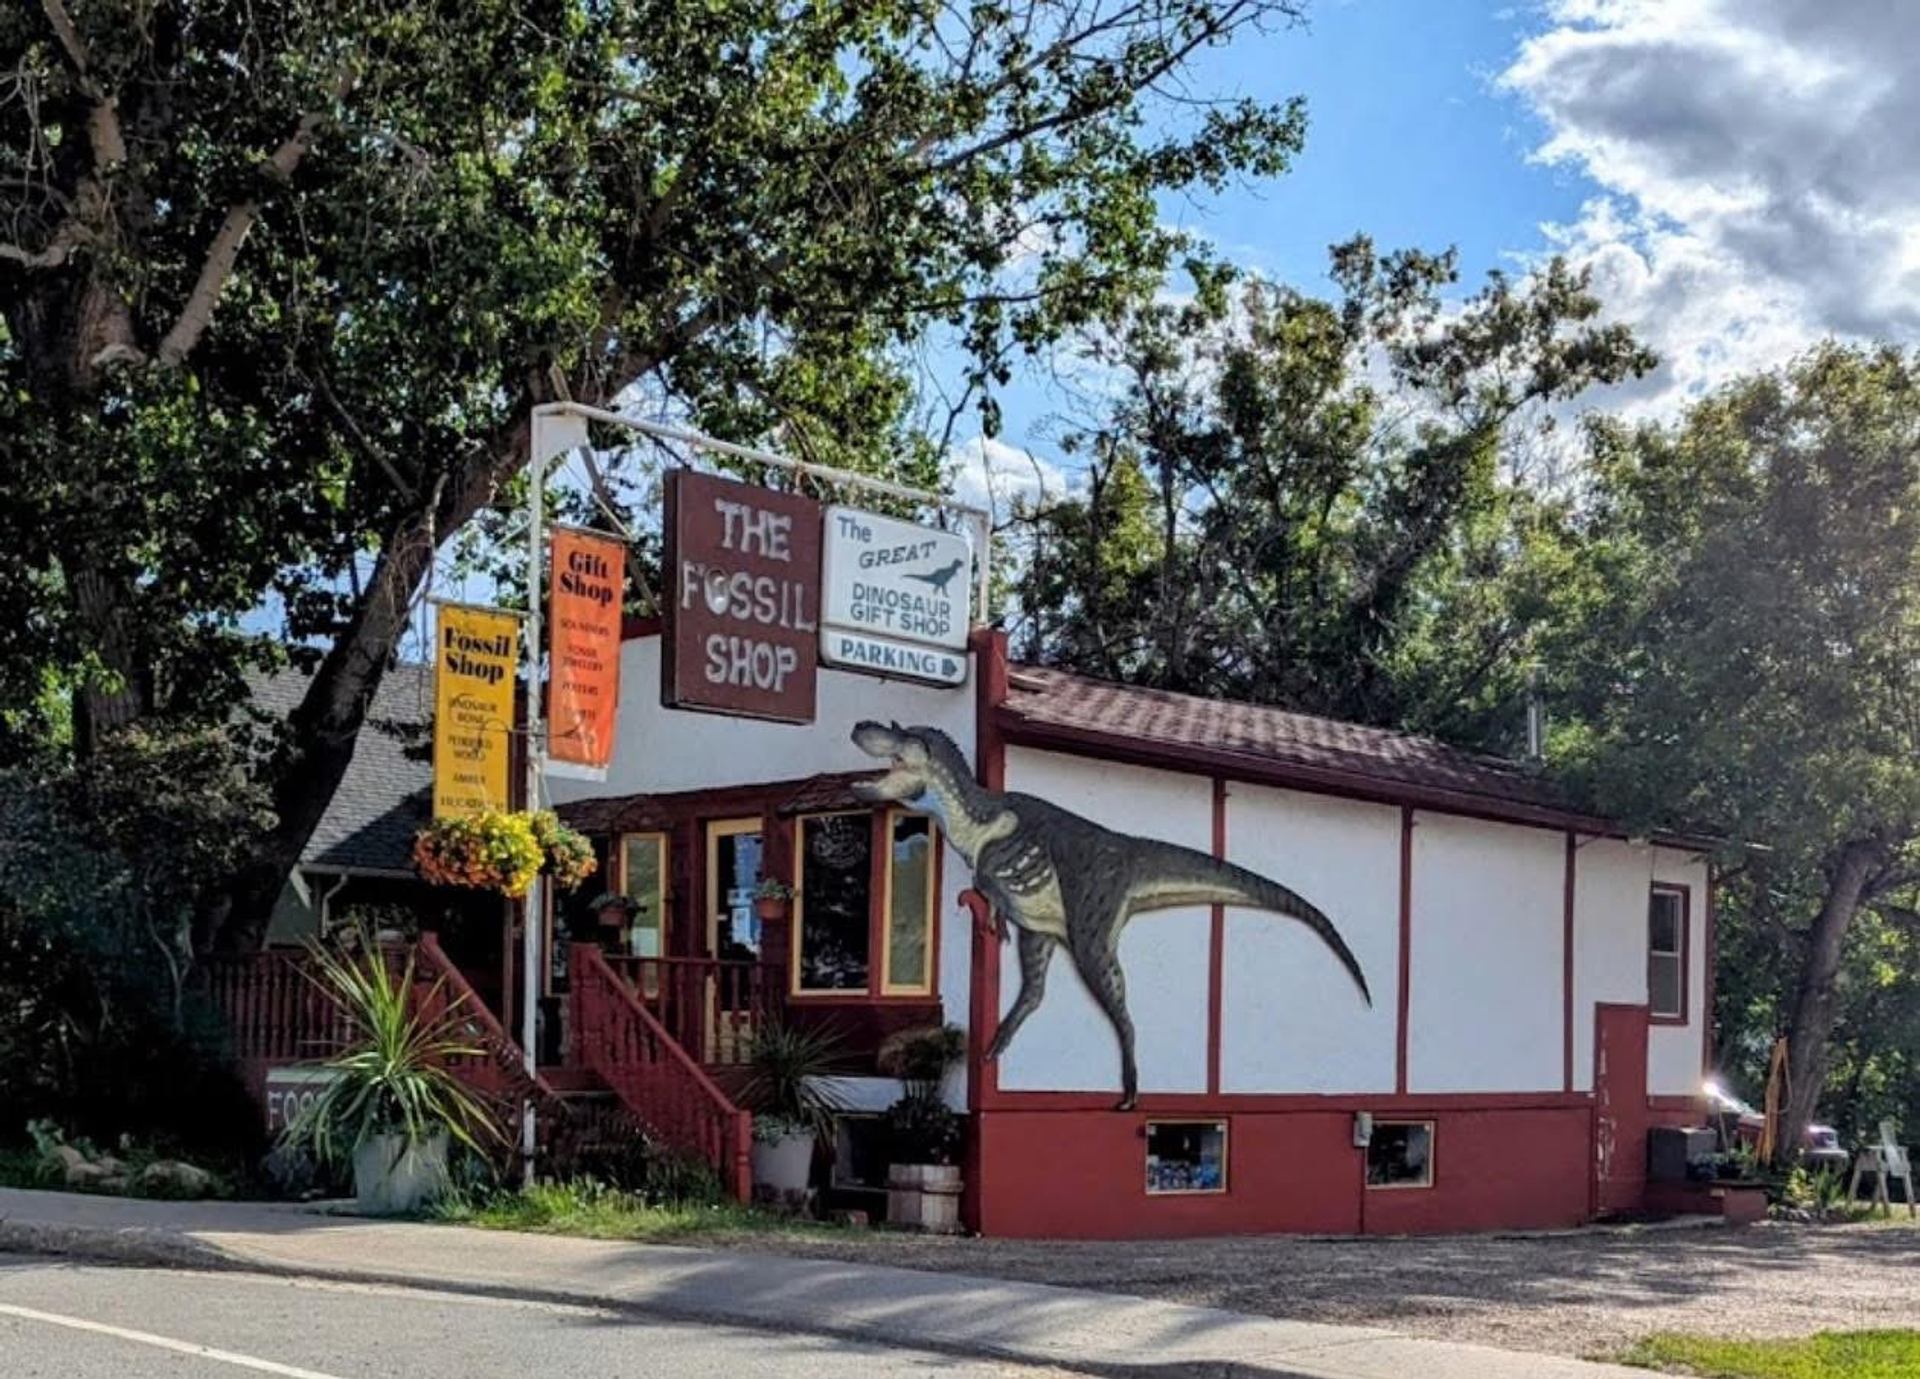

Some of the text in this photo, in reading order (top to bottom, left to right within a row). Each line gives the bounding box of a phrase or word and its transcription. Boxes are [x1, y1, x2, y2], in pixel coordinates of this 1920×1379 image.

[714, 497, 792, 562] THE
[837, 516, 873, 543] The
[569, 551, 609, 579] Gift
[859, 541, 937, 569] GREAT
[560, 572, 614, 607] Shop
[681, 561, 816, 633] FOSSIL
[852, 582, 951, 620] DINOSAUR
[850, 603, 951, 637] GIFT SHOP
[445, 627, 511, 657] Fossil
[841, 638, 937, 674] PARKING
[446, 652, 505, 686] Shop
[705, 634, 797, 692] SHOP
